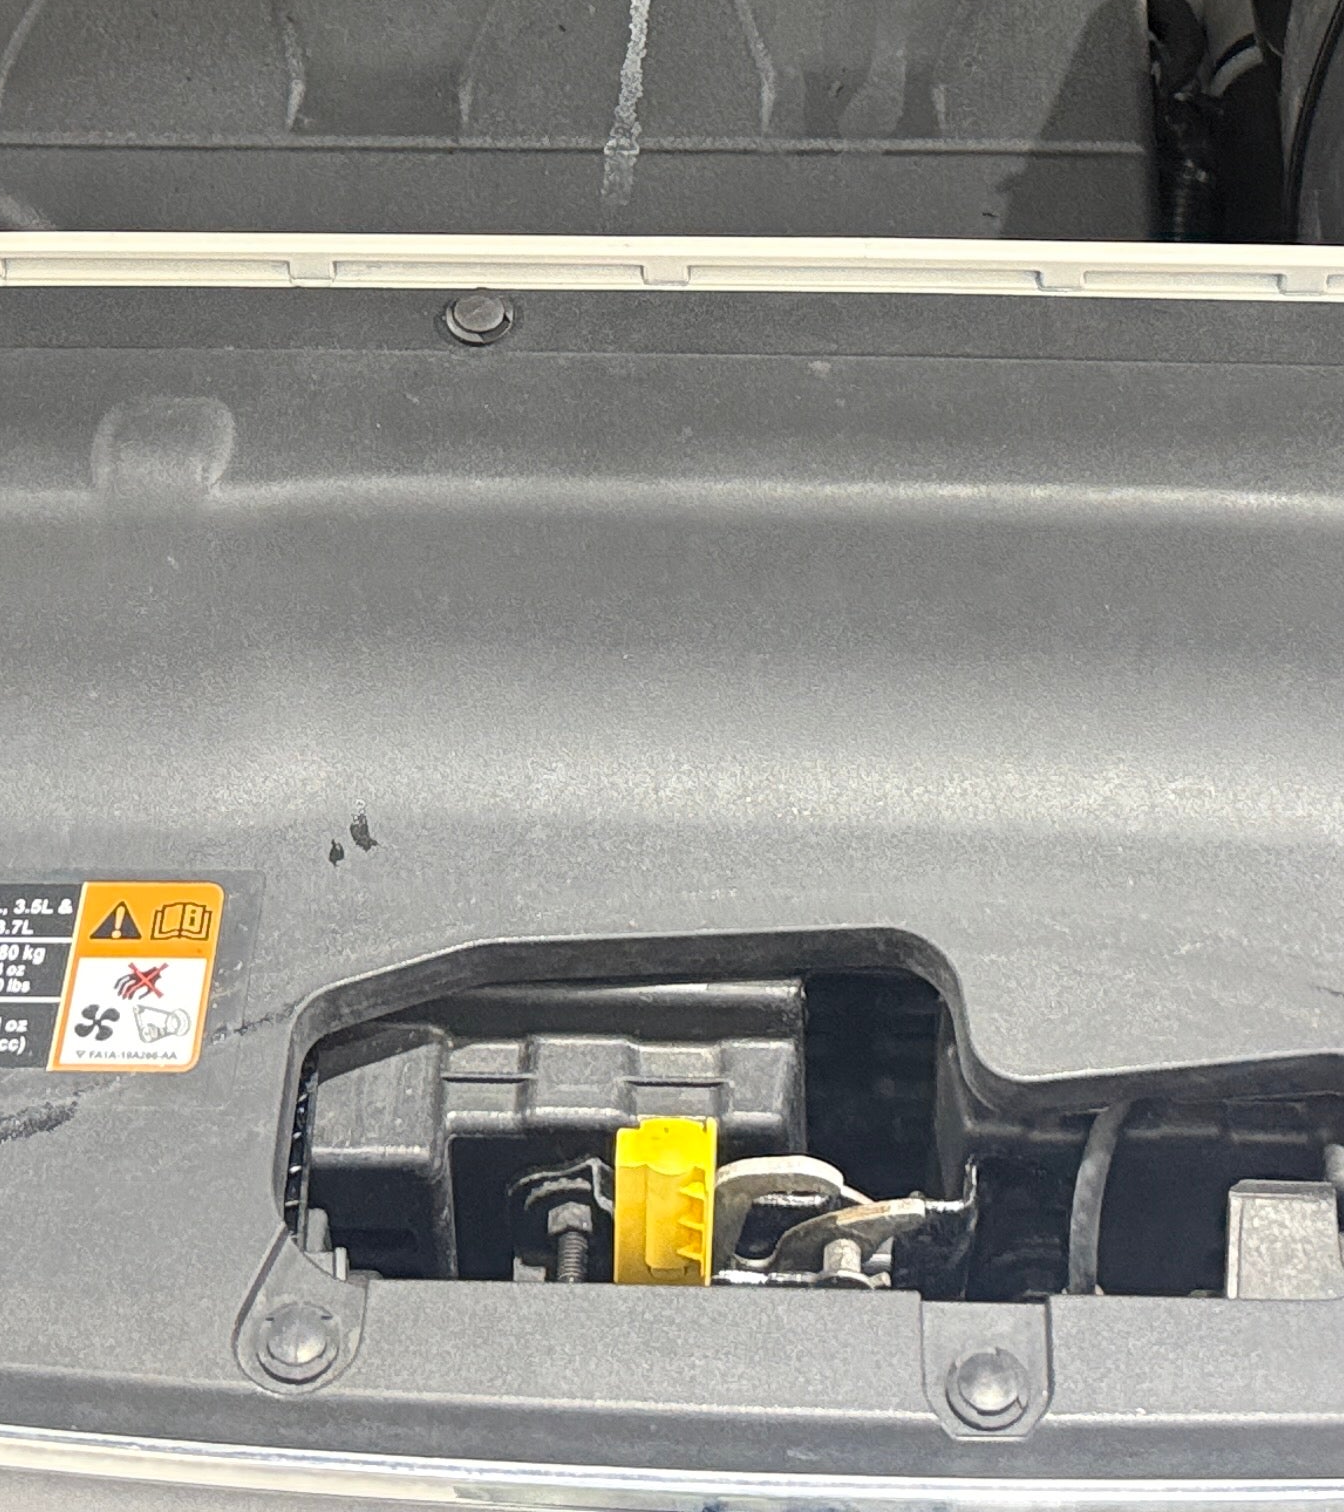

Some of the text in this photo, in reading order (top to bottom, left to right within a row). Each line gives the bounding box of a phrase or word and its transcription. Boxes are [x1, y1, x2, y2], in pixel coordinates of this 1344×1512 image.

[13, 899, 54, 915] 3.5L
[57, 899, 73, 915] &
[22, 945, 46, 965] kg
[6, 964, 26, 977] oz
[6, 978, 31, 993] lbs
[4, 1019, 28, 1033] oz
